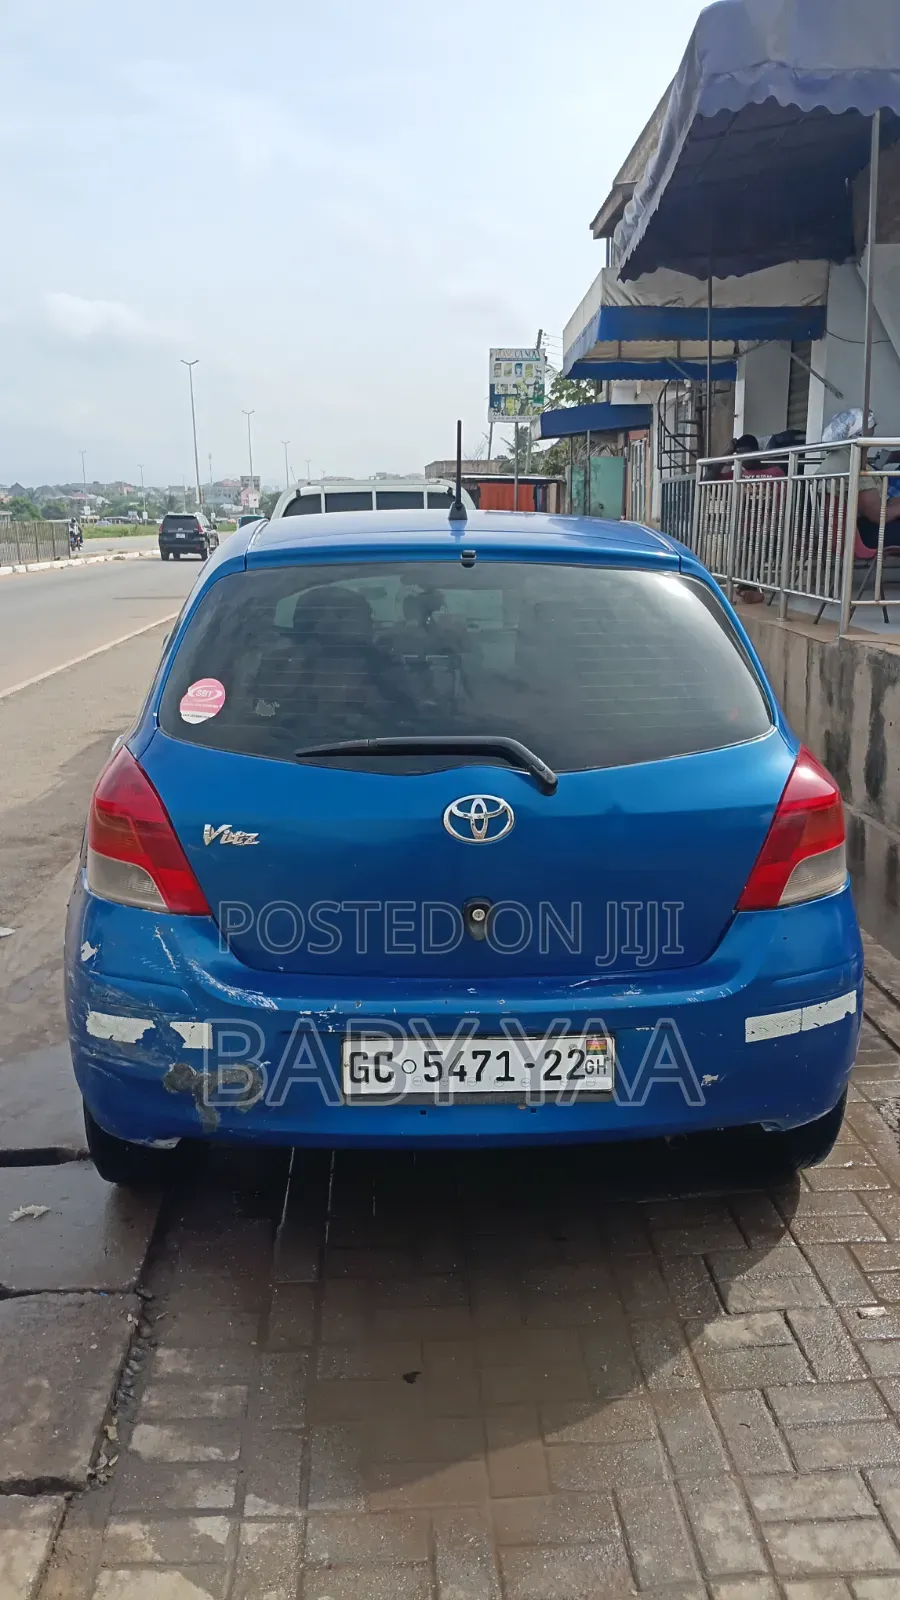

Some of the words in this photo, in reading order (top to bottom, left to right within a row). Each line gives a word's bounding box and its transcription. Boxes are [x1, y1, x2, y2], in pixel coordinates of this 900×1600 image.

[195, 689, 213, 699] SBT
[203, 823, 260, 846] Vitz
[349, 1051, 394, 1084] GC
[585, 1059, 607, 1076] GH
